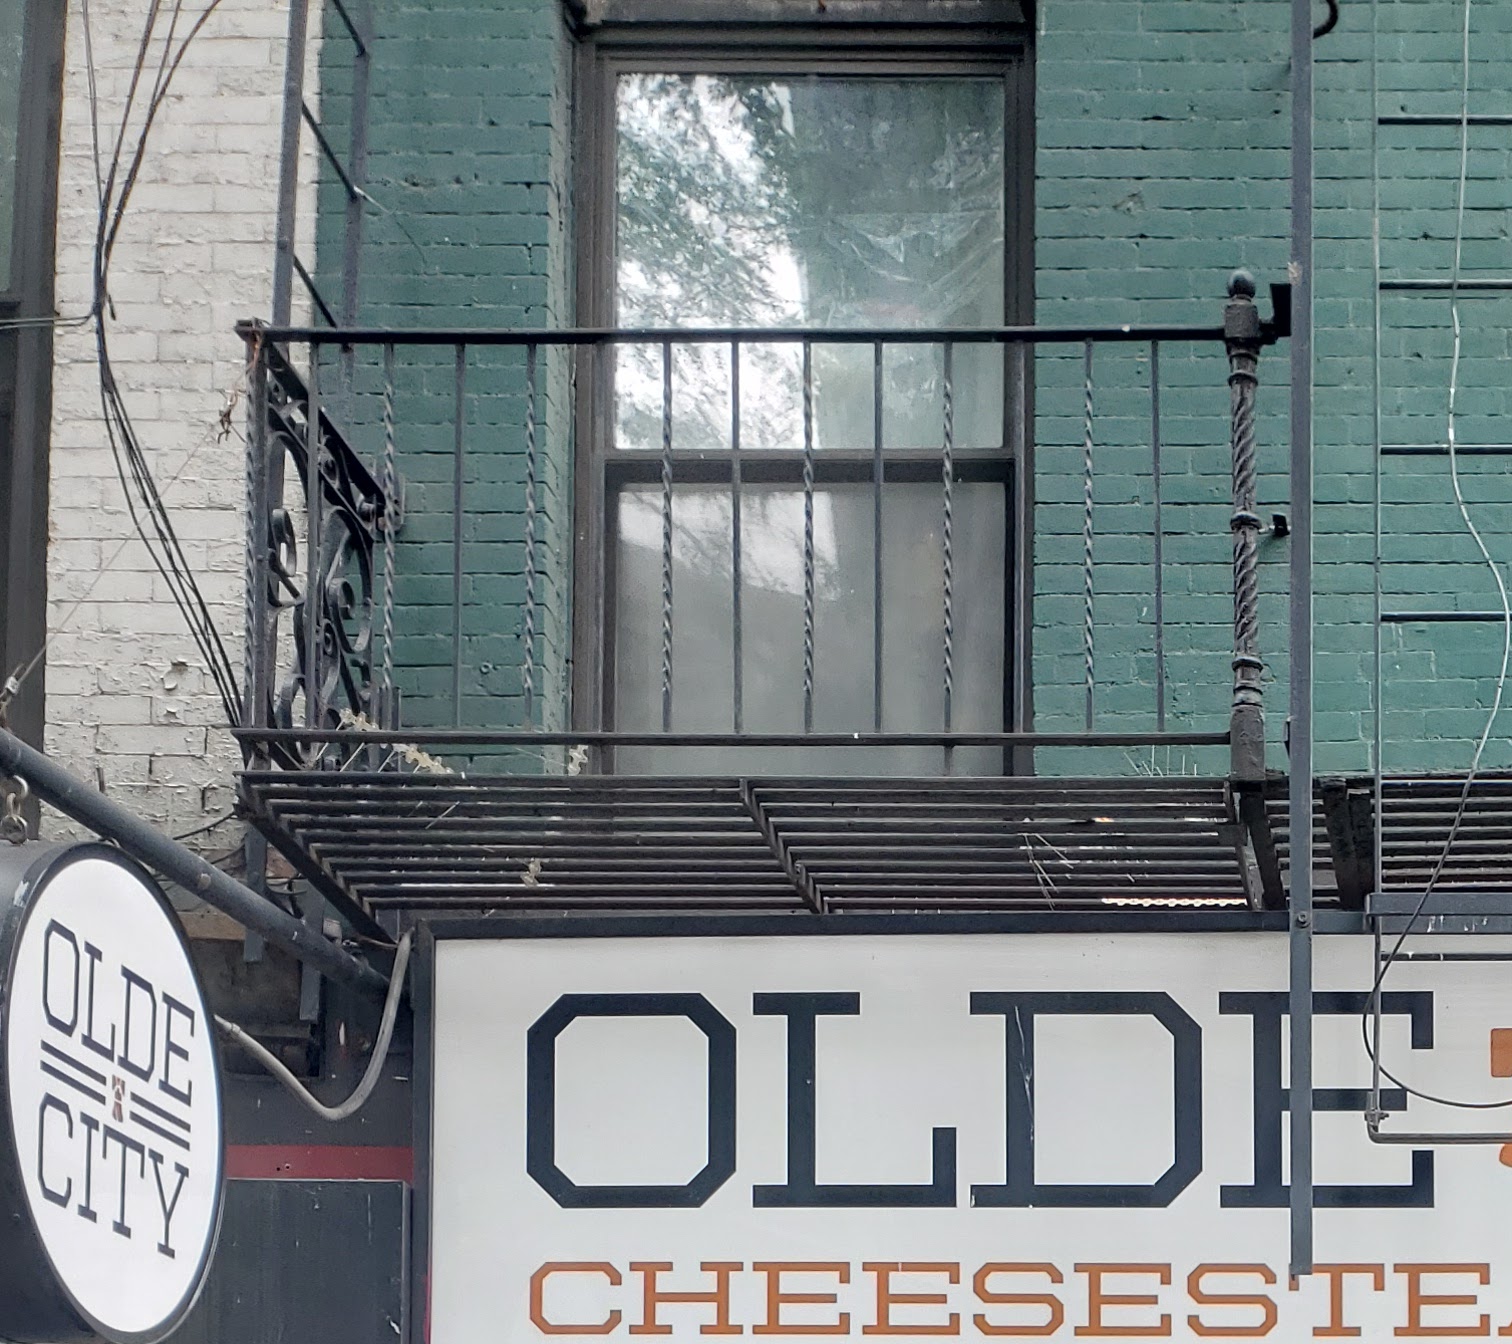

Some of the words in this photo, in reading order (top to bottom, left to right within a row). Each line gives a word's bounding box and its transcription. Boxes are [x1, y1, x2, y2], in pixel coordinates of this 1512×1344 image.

[42, 918, 195, 1107] OLDE
[526, 992, 1434, 1208] OLDE
[37, 1092, 189, 1259] CITY
